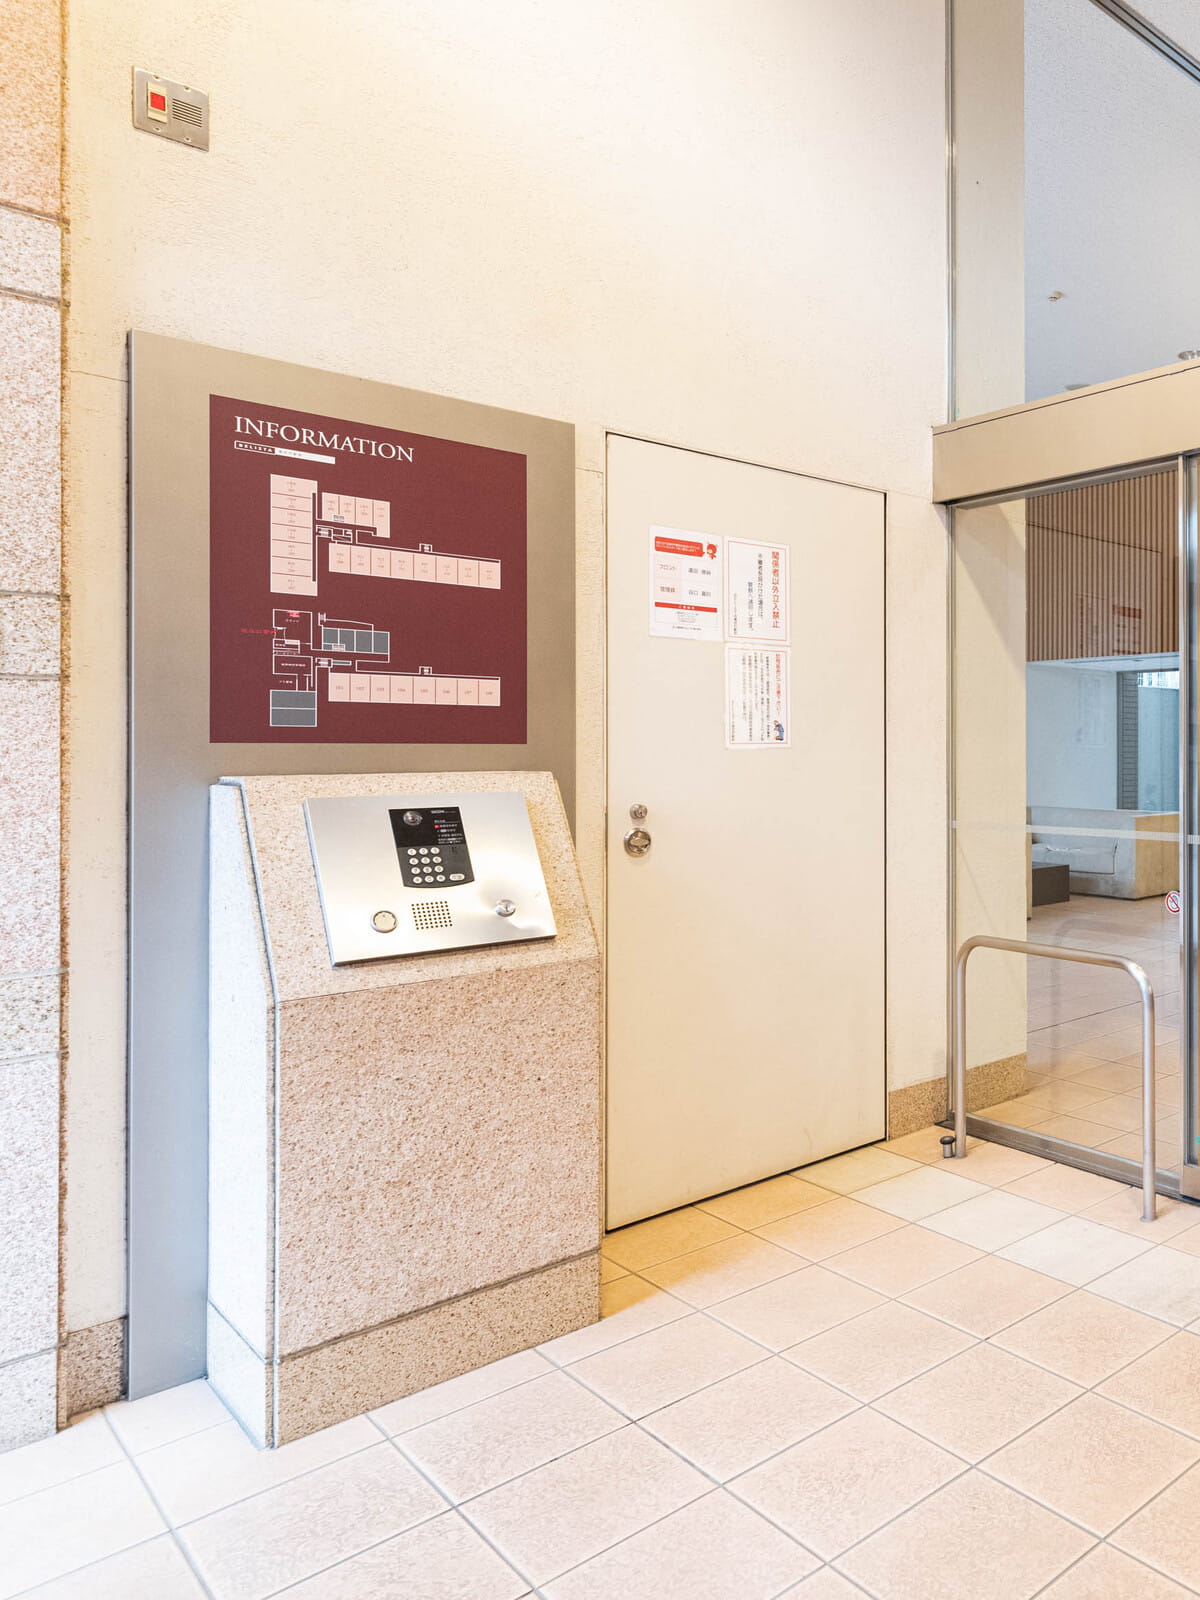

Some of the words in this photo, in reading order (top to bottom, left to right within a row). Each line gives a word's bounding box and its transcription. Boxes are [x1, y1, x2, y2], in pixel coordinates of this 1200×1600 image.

[234, 415, 414, 463] INFORMATION
[771, 551, 780, 629] 関係者以外立入禁止
